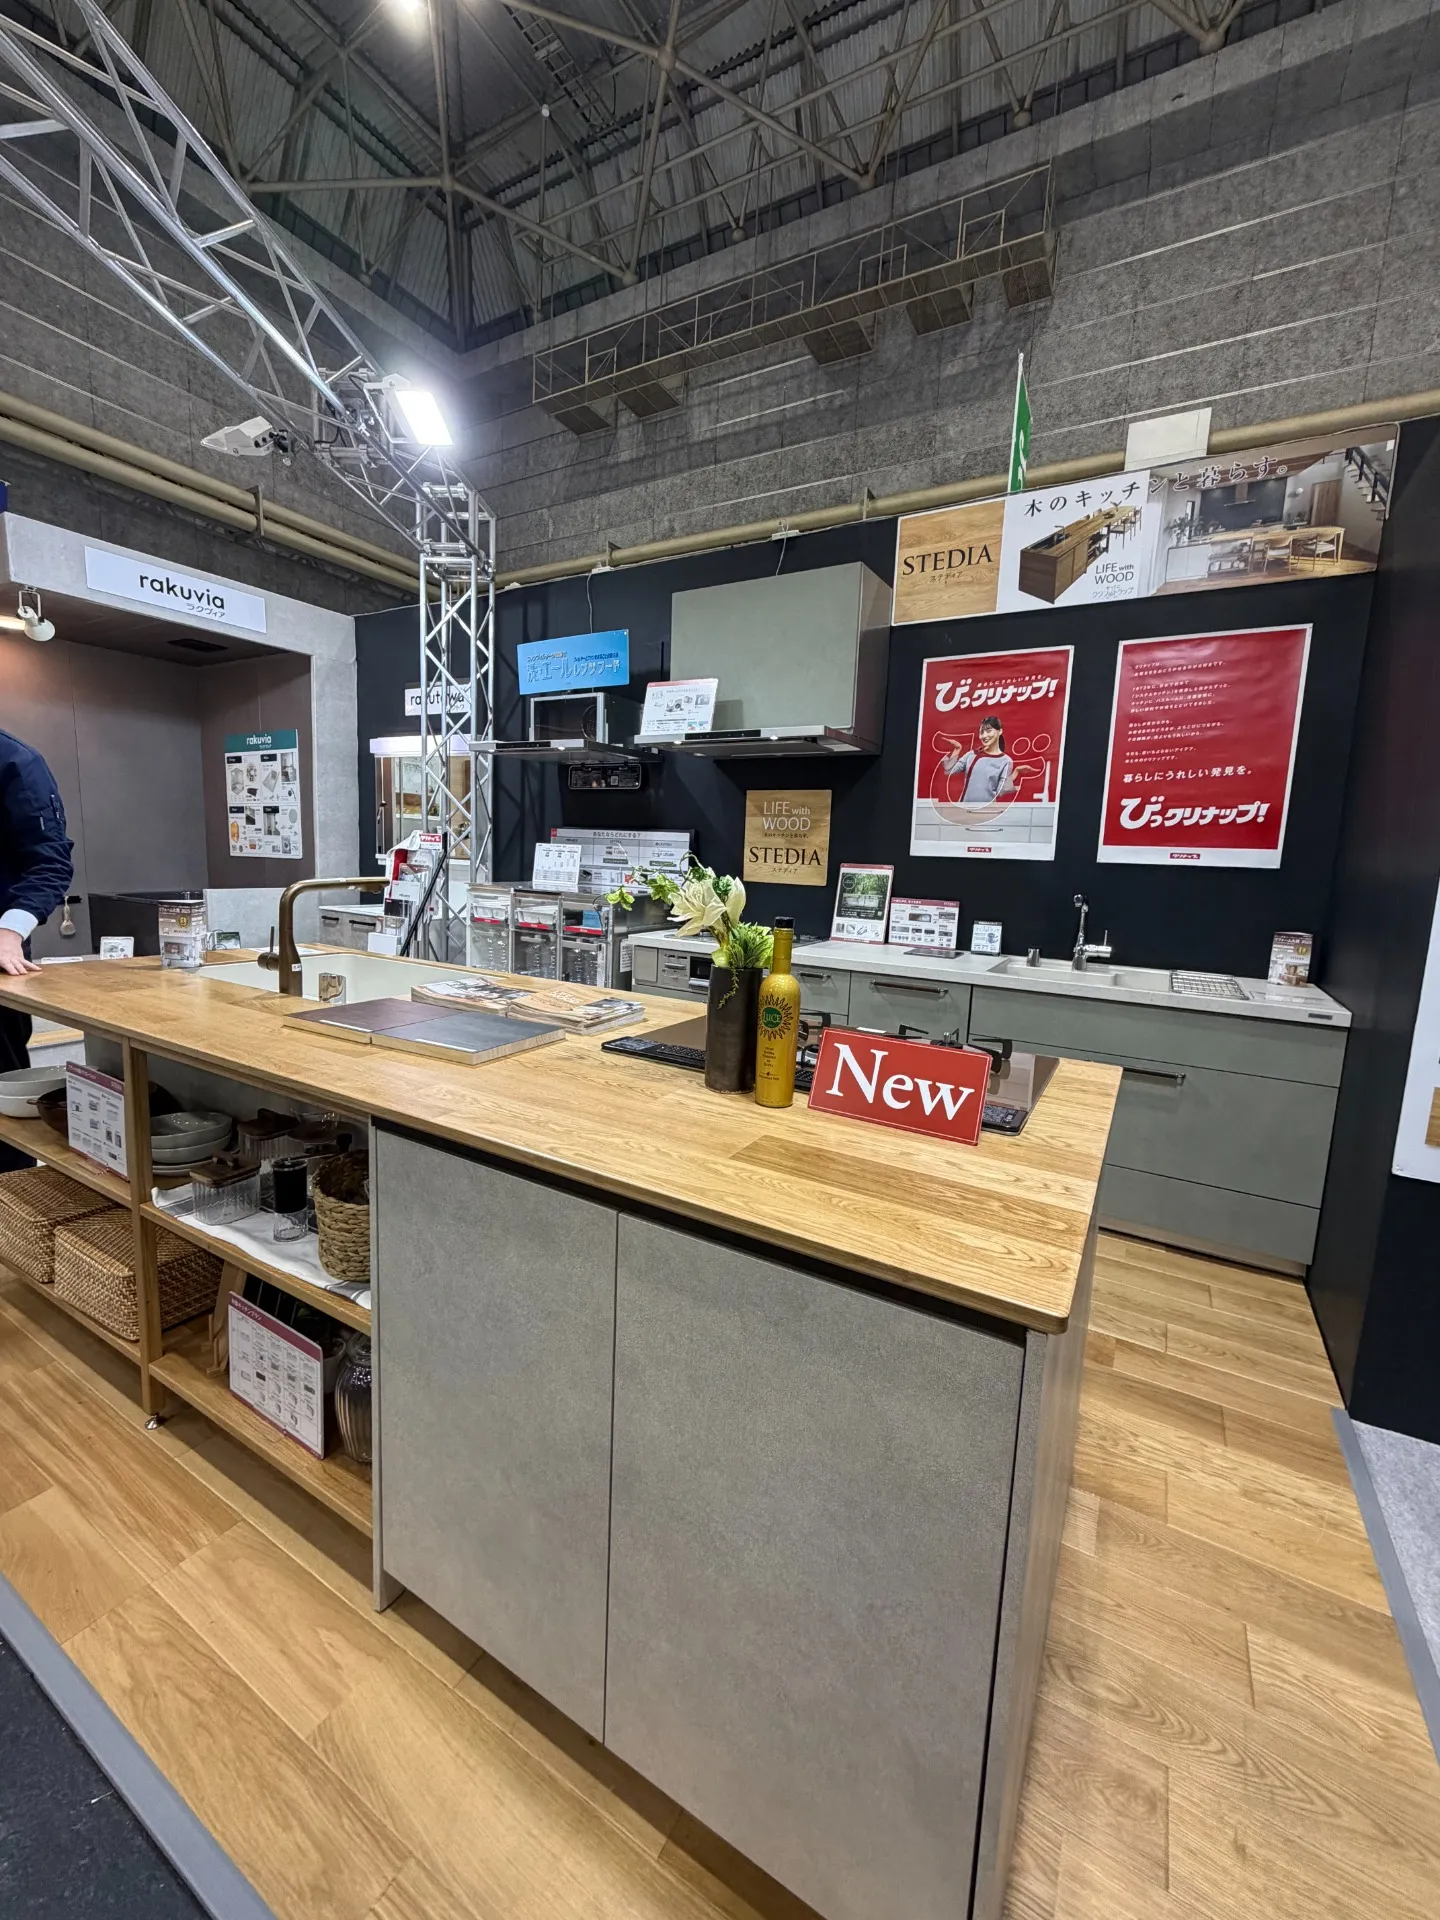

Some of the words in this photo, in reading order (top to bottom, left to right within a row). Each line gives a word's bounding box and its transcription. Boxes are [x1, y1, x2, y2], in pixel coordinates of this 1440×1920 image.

[1024, 456, 1288, 518] 木のキッチンと暮らす。
[902, 544, 993, 576] STEDIA
[1095, 562, 1118, 575] LIFE
[929, 571, 963, 584] ステディア
[1094, 571, 1134, 585] WOOD
[139, 574, 225, 610] rakuvia
[186, 602, 226, 618] ラクヴィア
[935, 678, 1059, 712] びっクリナップ!
[246, 733, 272, 745] rakuvia
[1123, 765, 1252, 783] 暮らしにうれしい発見を。
[763, 801, 790, 815] LIFE
[791, 806, 811, 815] with
[1119, 795, 1270, 830] びっクリナップ!
[762, 817, 811, 831] WOOD
[748, 846, 823, 867] STEDIA
[826, 1042, 976, 1121] New
